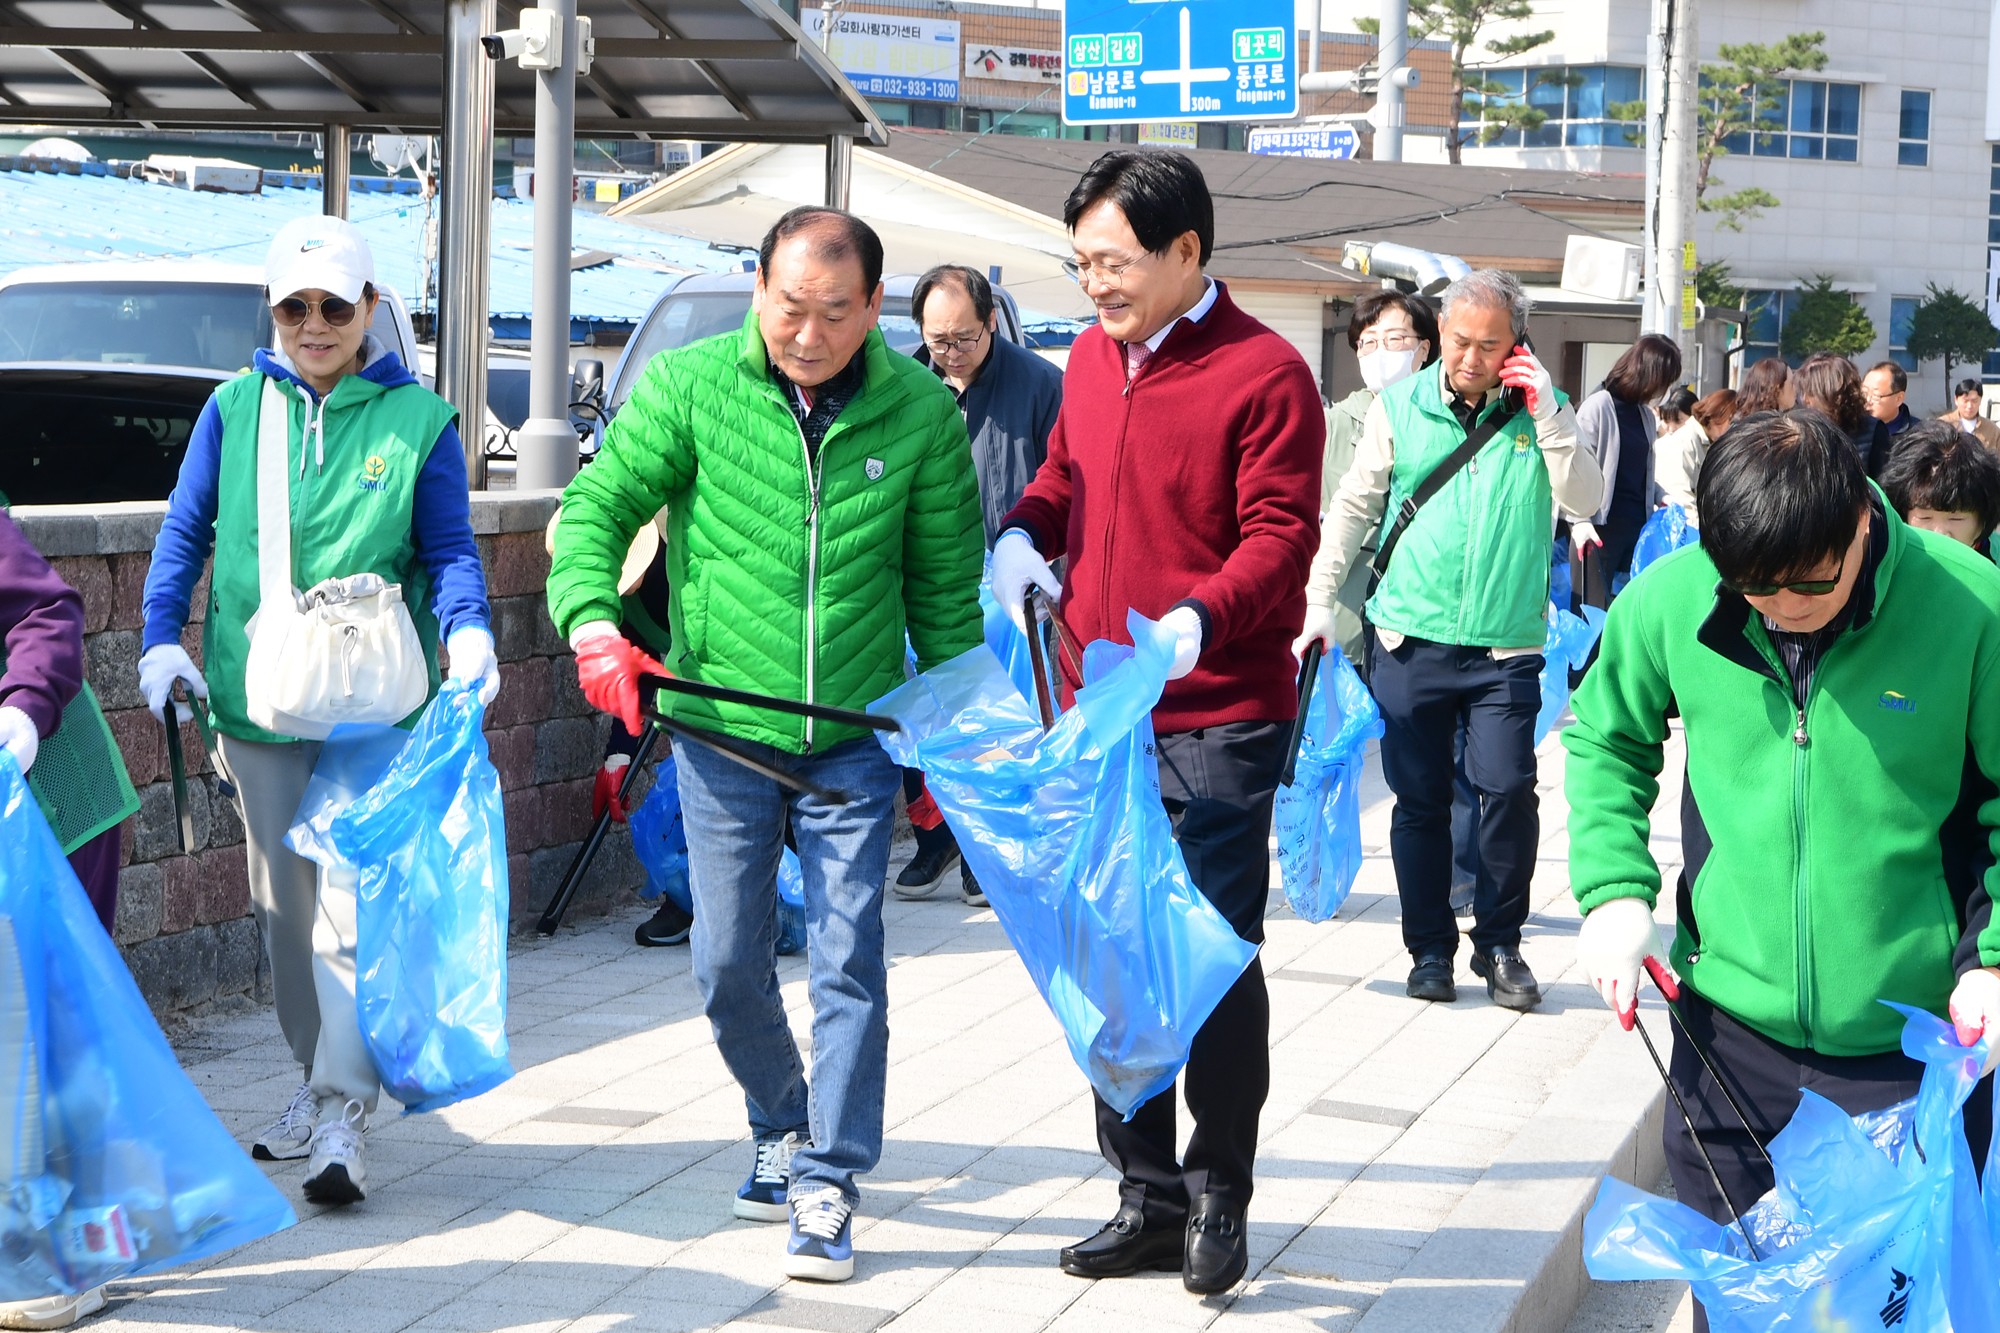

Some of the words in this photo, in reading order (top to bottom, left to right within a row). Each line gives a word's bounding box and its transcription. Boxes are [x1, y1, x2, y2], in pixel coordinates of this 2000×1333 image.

[1073, 40, 1101, 62] 삼산
[1111, 38, 1137, 61] 길상
[1237, 33, 1280, 57] 월곳리
[1071, 76, 1085, 92] 84
[1089, 70, 1136, 95] 남문로
[1236, 64, 1285, 89] 동문로
[883, 78, 956, 99] 032-933-1300
[1236, 89, 1285, 104] Dongmun-ro
[1191, 96, 1221, 112] 300m
[1253, 131, 1330, 151] 강화대로352번길
[358, 477, 387, 491] SMU
[1878, 693, 1917, 713] SMU
